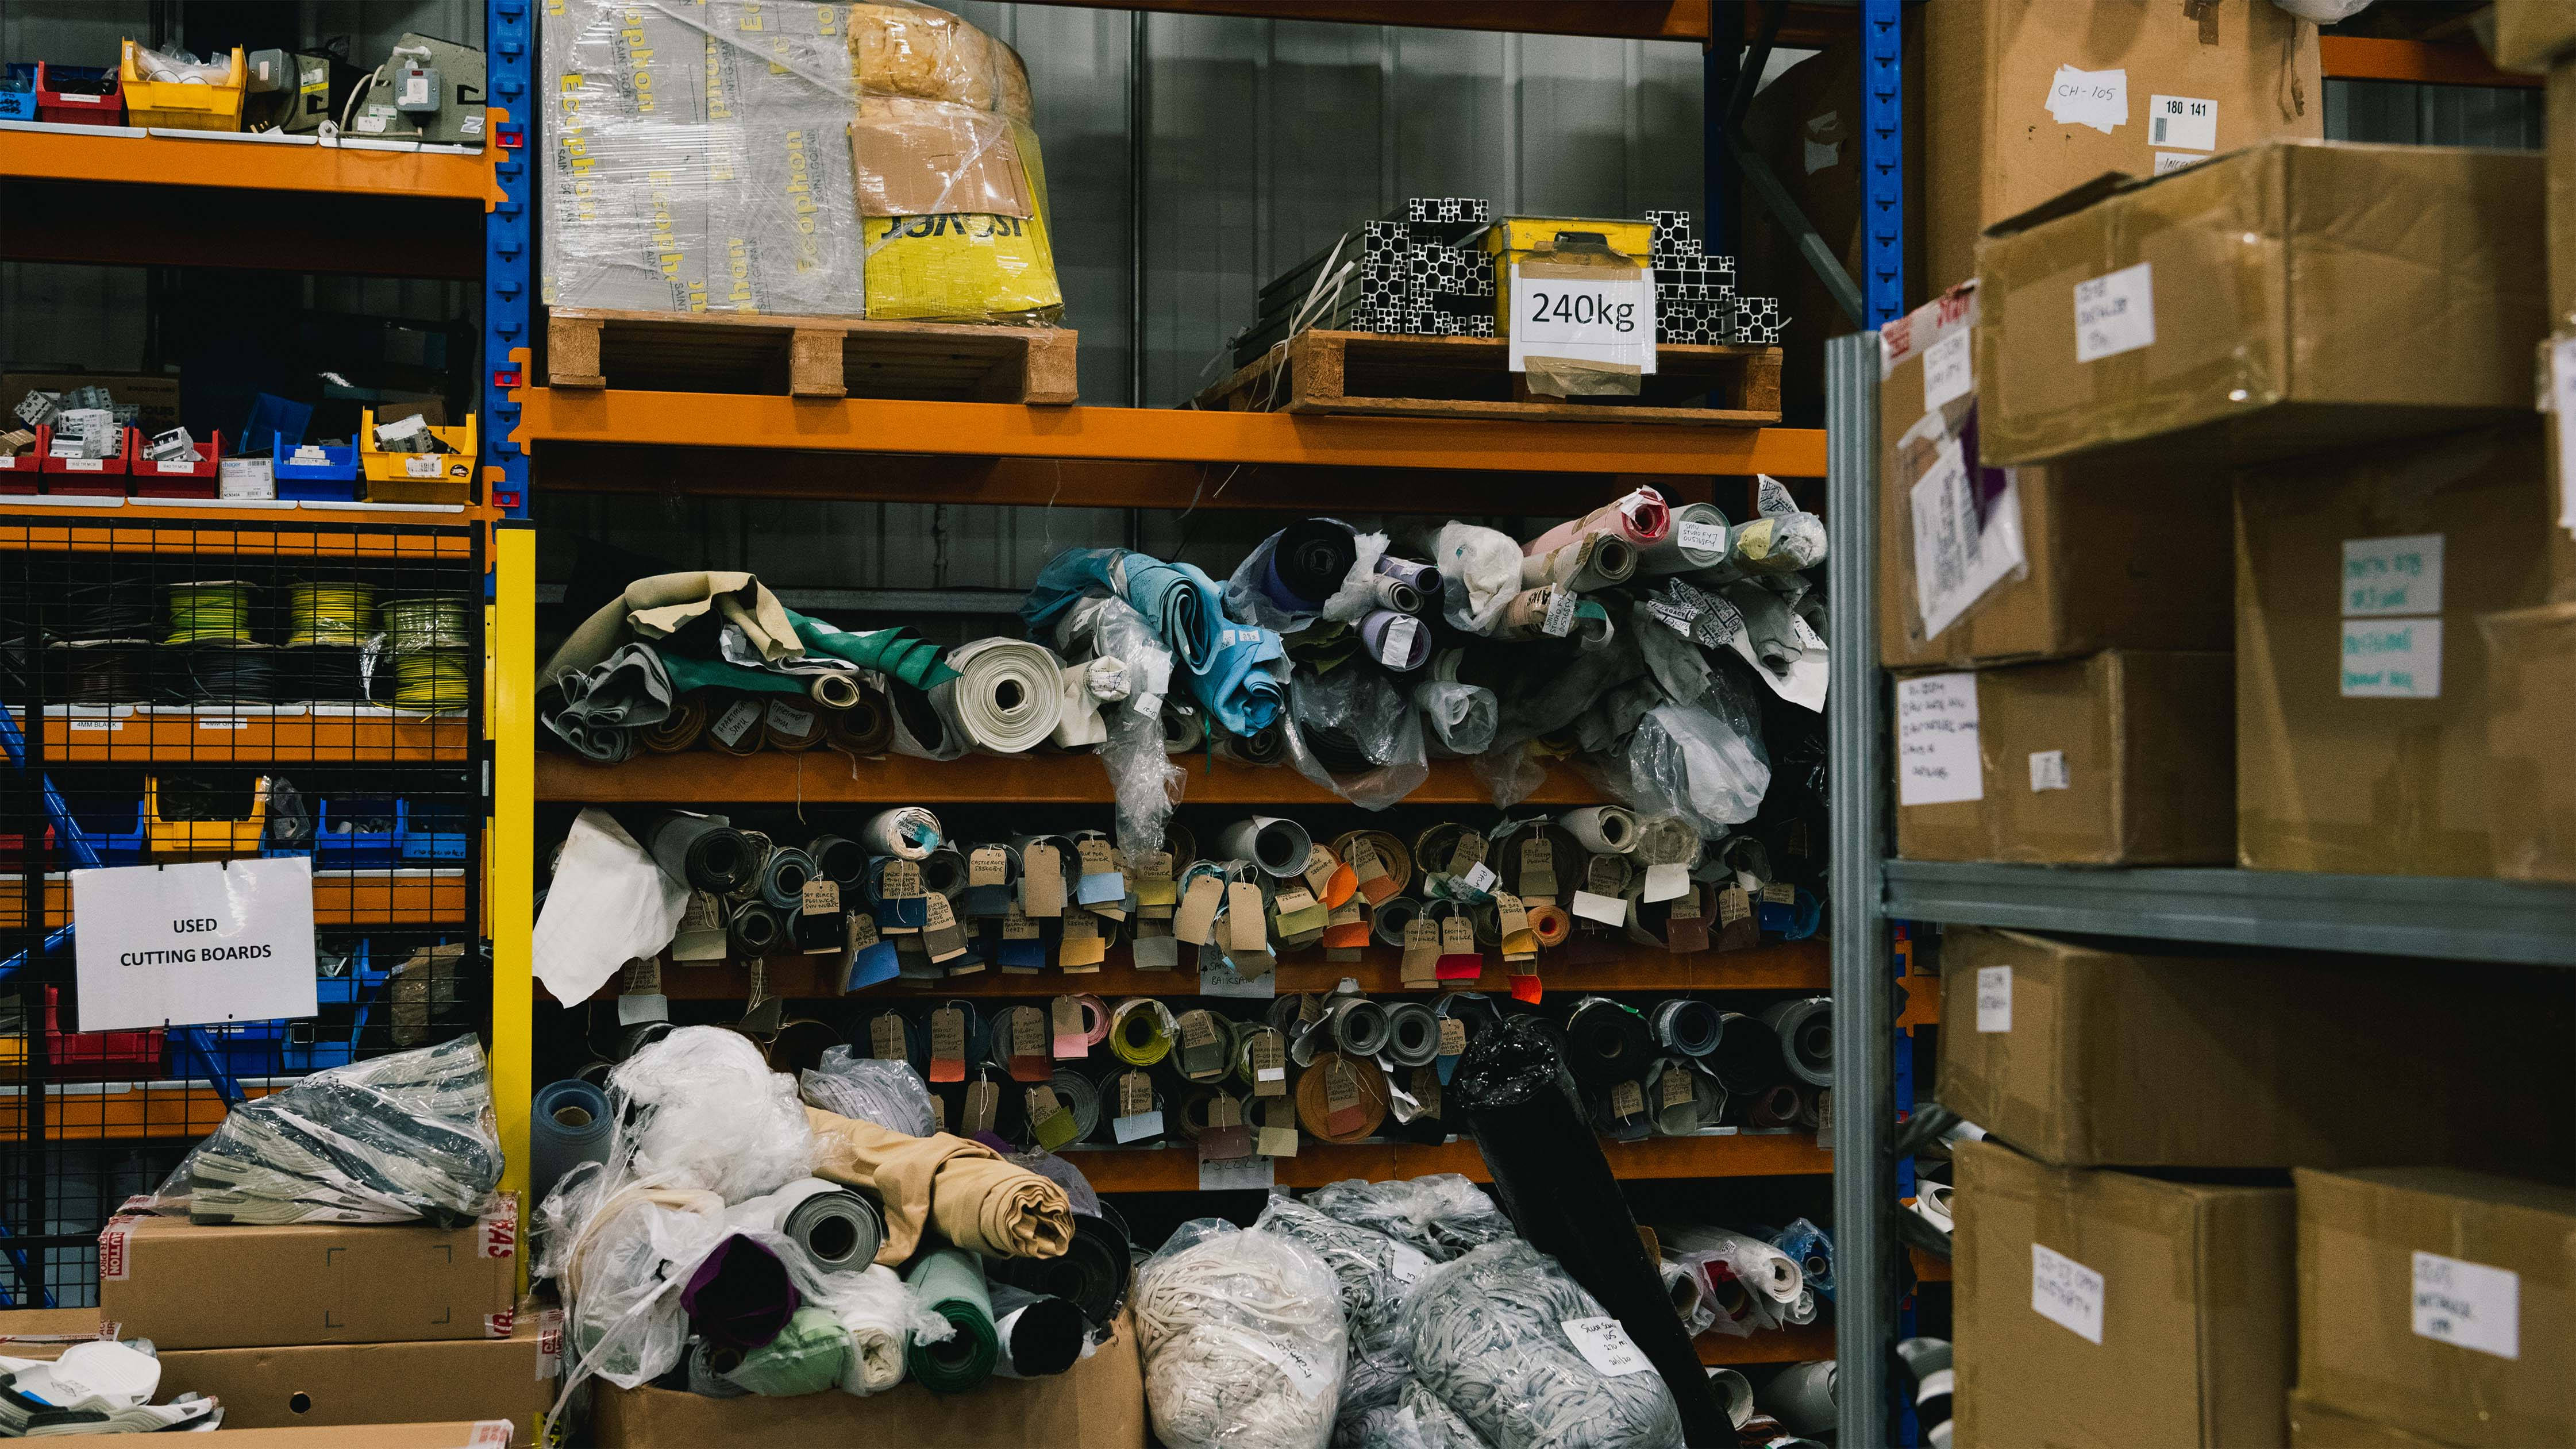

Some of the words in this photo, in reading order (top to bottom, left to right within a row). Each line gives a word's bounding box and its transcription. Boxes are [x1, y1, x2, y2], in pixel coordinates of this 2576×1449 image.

[2167, 101, 2183, 114] 180
[2191, 103, 2206, 116] 141
[1532, 292, 1635, 333] 240kg
[174, 918, 217, 933] USED
[120, 949, 196, 966] CUTTING
[201, 944, 272, 962] BOARDS
